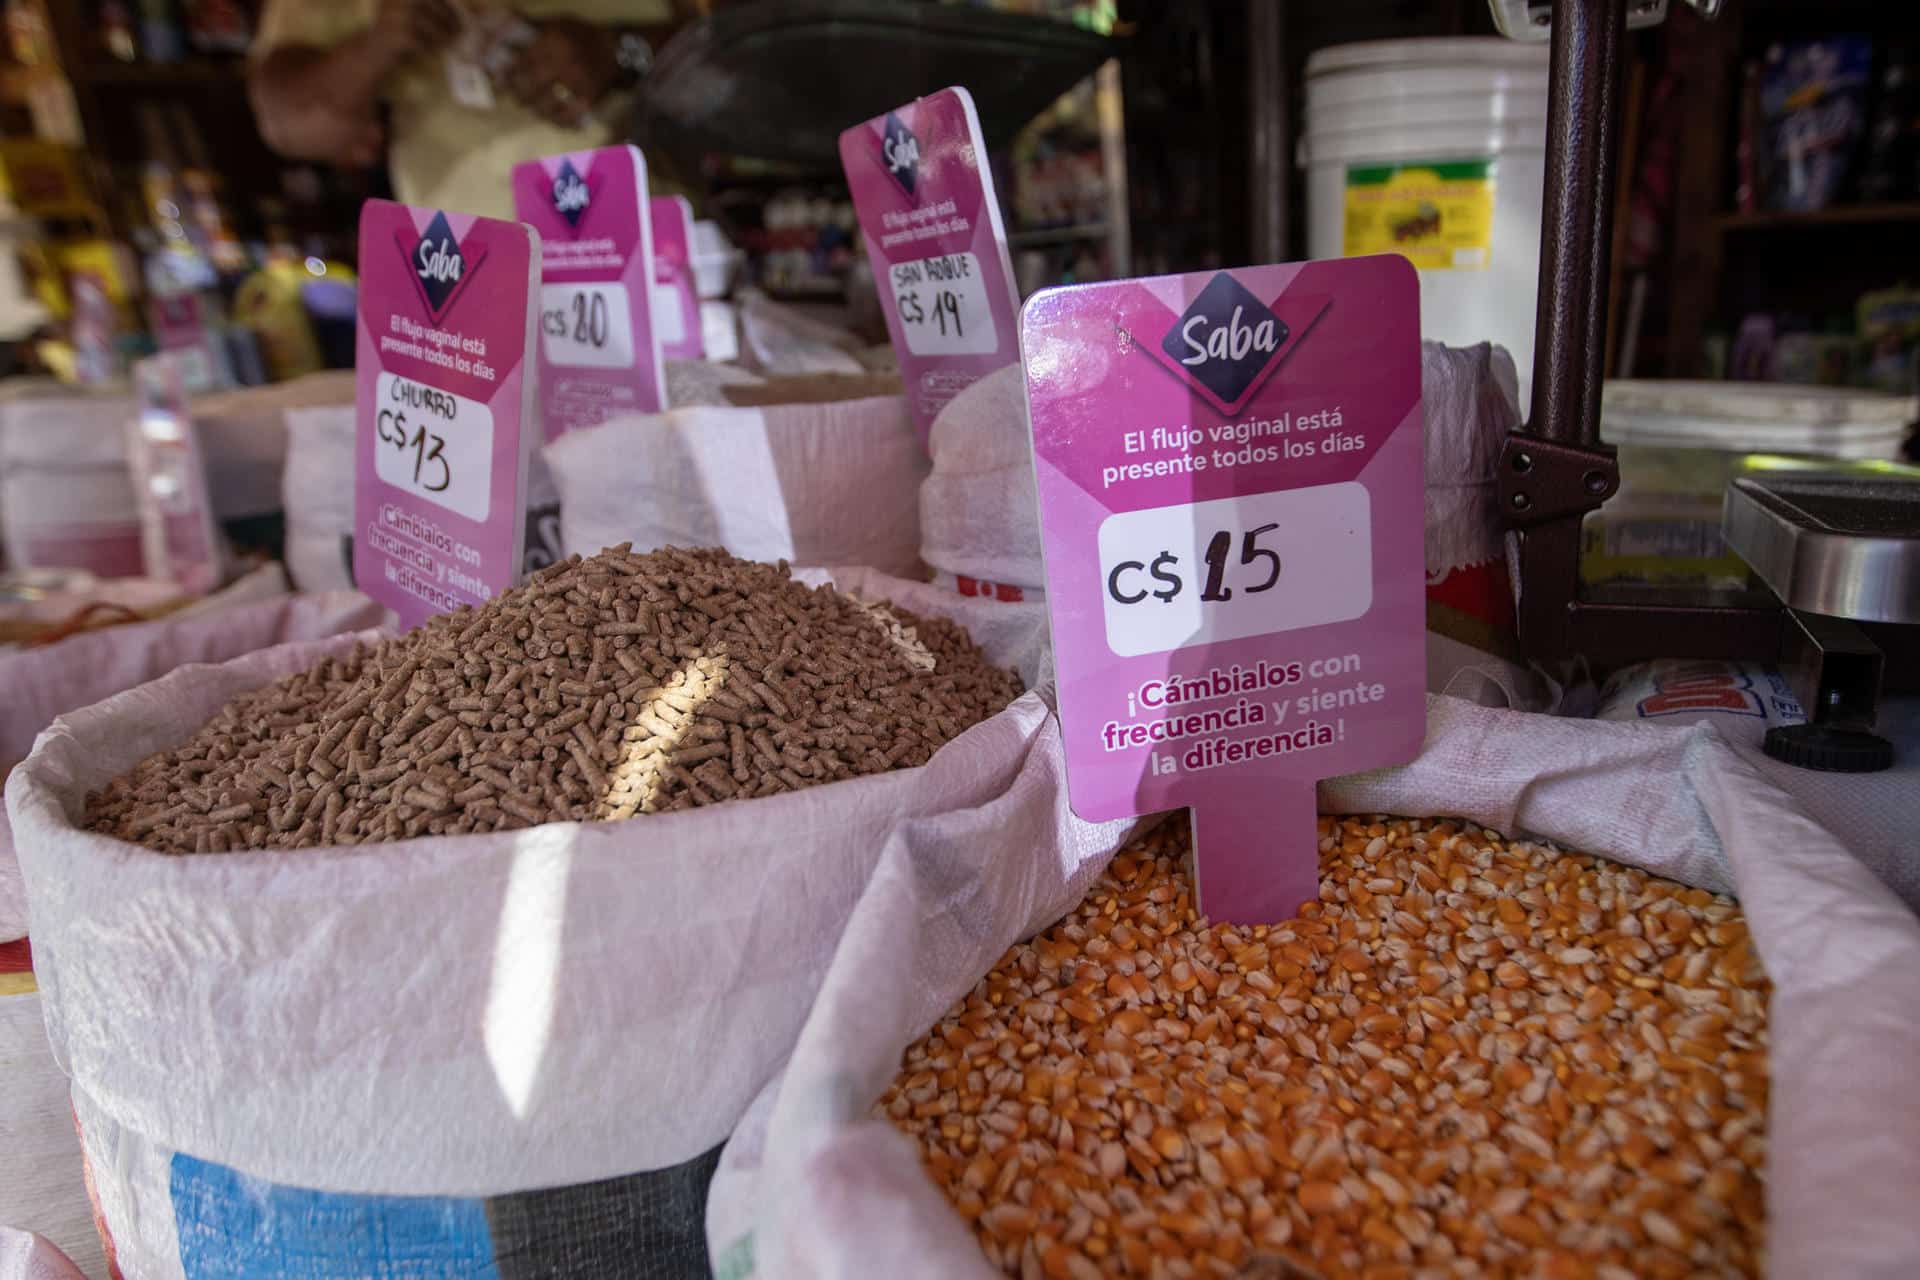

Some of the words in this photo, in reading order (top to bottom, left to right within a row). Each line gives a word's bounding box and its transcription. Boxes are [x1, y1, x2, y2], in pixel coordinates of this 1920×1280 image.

[884, 130, 920, 173] Saba
[554, 175, 590, 212] Saba
[417, 238, 462, 283] Saba
[894, 264, 922, 287] SAN
[391, 314, 401, 332] El
[401, 316, 423, 342] flujo
[424, 328, 461, 349] vaginal
[462, 337, 486, 356] está
[573, 291, 608, 348] 20
[1182, 305, 1280, 366] Saba
[381, 336, 422, 359] presente
[424, 346, 455, 369] todos
[455, 353, 471, 374] los
[472, 359, 495, 381] días
[391, 375, 457, 421] CHURRO
[378, 409, 407, 451] C$
[410, 424, 450, 491] 13
[1124, 432, 1145, 454] El
[1151, 425, 1204, 451] flujo
[1208, 413, 1290, 444] vaginal
[1296, 406, 1343, 430] está
[1103, 451, 1208, 488] presente
[1212, 444, 1279, 468] todos
[1284, 439, 1317, 458] los
[1321, 431, 1366, 454] días
[368, 523, 433, 576] frecuencia
[436, 562, 446, 582] y
[448, 566, 491, 600] siente
[385, 559, 397, 583] la
[455, 543, 481, 568] con
[1108, 551, 1183, 604] C$
[1200, 523, 1282, 602] 15
[1127, 660, 1302, 718] ¡Cámbialos
[1308, 653, 1361, 678] con
[1103, 699, 1266, 752] frecuencia
[1272, 701, 1289, 724] y
[1296, 682, 1386, 715] siente
[1151, 752, 1177, 776] la
[1183, 718, 1345, 771] diferencia!
